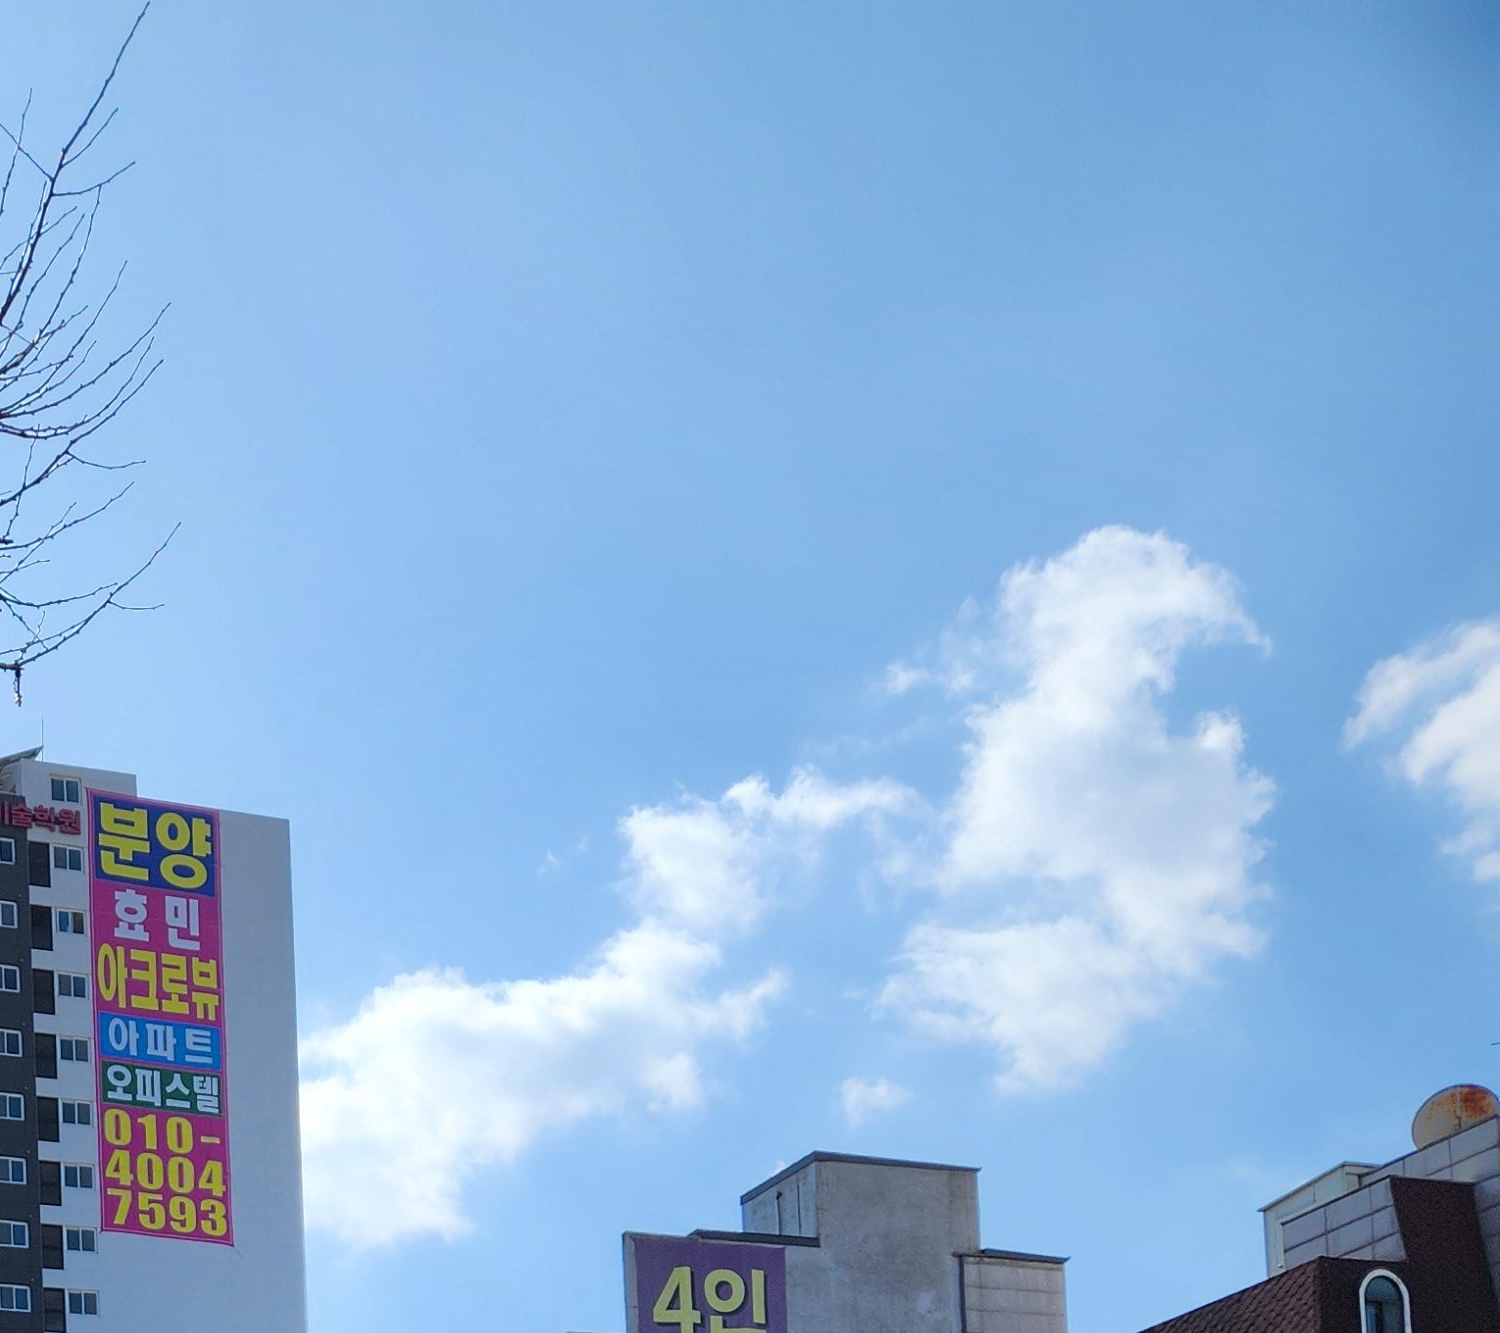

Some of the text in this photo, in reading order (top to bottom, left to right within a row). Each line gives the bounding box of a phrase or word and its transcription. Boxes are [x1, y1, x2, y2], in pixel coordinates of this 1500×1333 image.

[99, 802, 211, 889] 분양
[98, 943, 219, 1020] 아크로뷰
[108, 1018, 213, 1064] 아파트
[107, 1064, 219, 1114] 오피스텔
[104, 1108, 220, 1154] 010-
[105, 1149, 226, 1197] 4004
[107, 1188, 227, 1236] 7593
